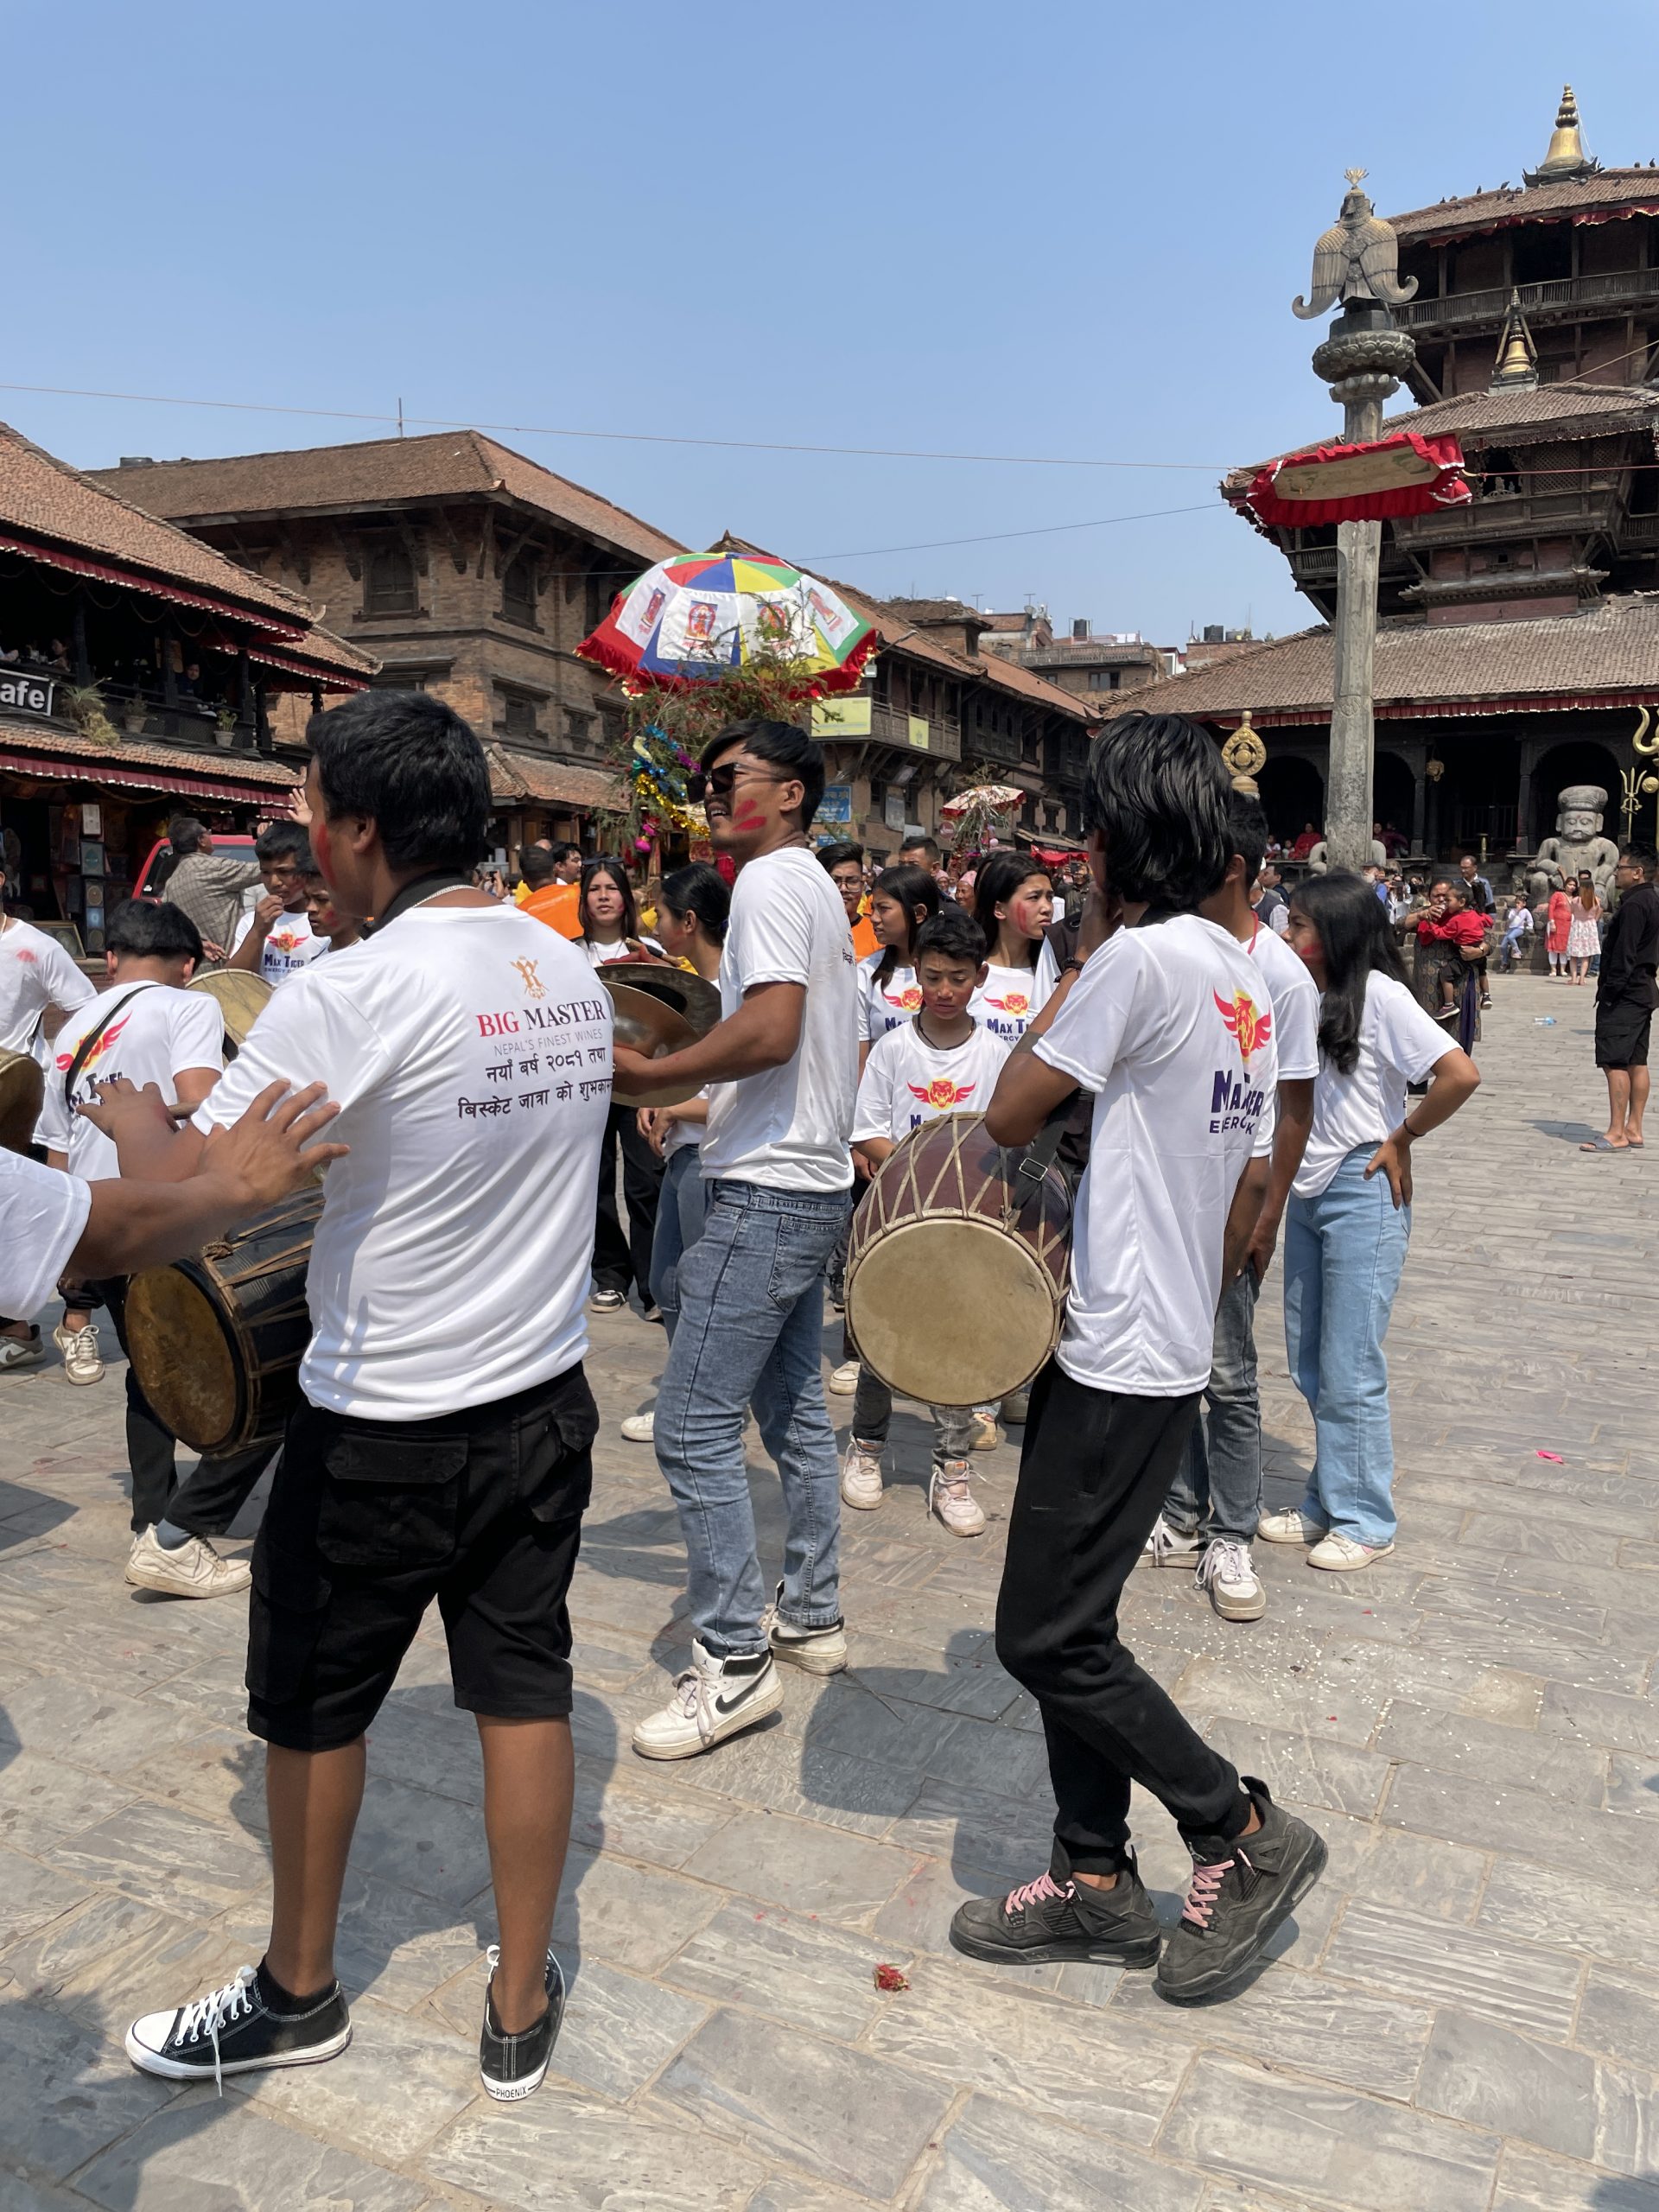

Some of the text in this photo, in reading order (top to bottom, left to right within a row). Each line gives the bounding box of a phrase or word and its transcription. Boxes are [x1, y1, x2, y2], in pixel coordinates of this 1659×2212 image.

[264, 954, 281, 966] MAX
[476, 1000, 607, 1038] BIG MASTER
[987, 1019, 1013, 1034] MAX
[493, 1028, 603, 1058] NEPAL'S FINEST WINES
[485, 1058, 513, 1084] नयाँ
[545, 1050, 583, 1071] २०८१
[457, 1096, 512, 1119] बिस्केट
[518, 1090, 550, 1109] जात्रा
[556, 1081, 574, 1102] को
[496, 2087, 526, 2098] PHOENIX
